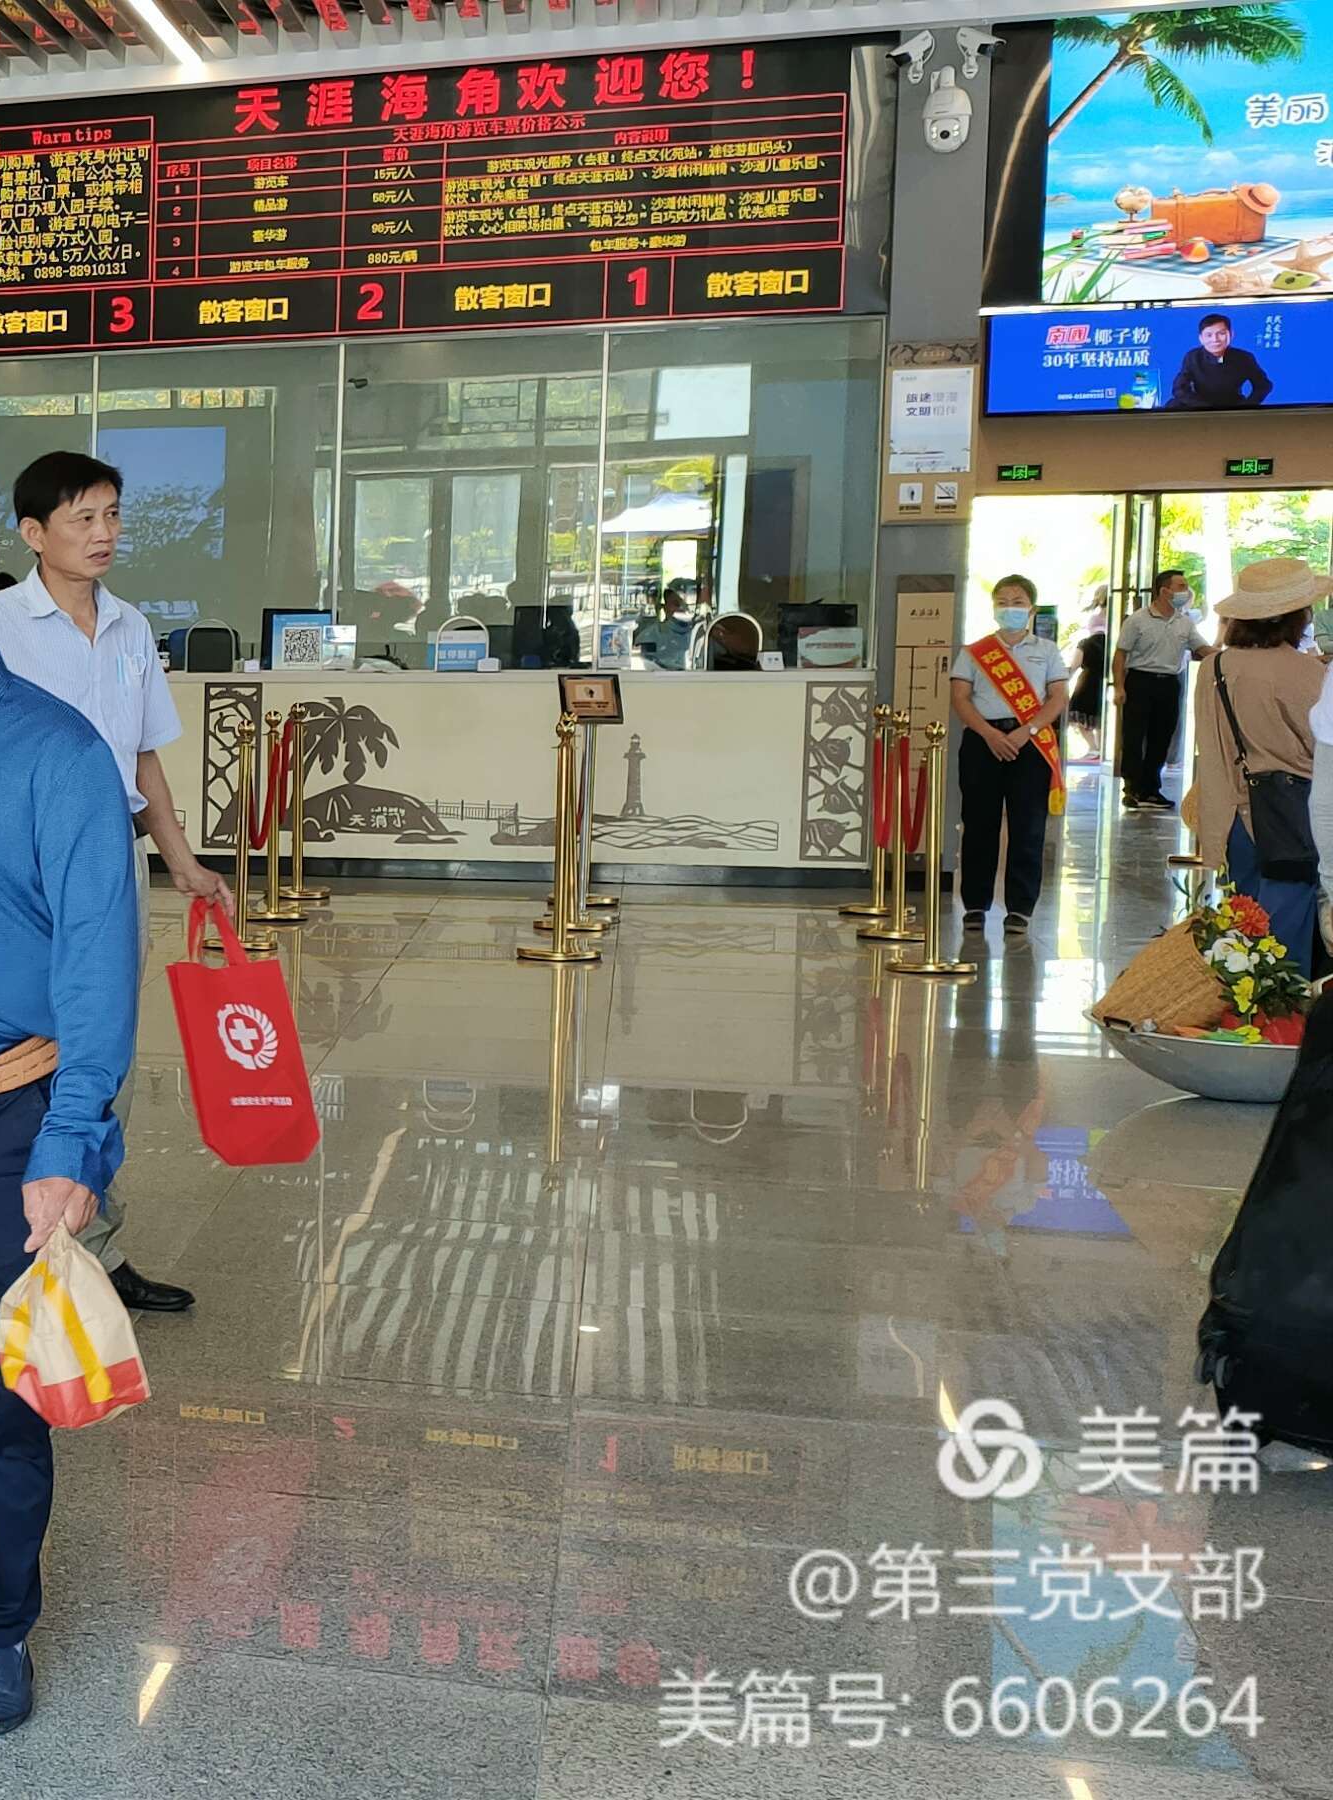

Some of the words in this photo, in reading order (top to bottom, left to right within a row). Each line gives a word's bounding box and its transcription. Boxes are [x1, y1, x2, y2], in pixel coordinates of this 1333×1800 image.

[1245, 93, 1328, 128] 美丽
[33, 130, 70, 146] Warm
[75, 127, 112, 143] tips
[166, 165, 191, 176] 序号
[173, 206, 181, 216] 2
[173, 236, 181, 246] 3
[173, 266, 180, 276] 4
[109, 297, 134, 333] 3
[198, 297, 289, 325] 散客窗口
[356, 283, 384, 320] 2
[454, 283, 552, 311] 散客窗口
[627, 267, 648, 307] 1
[706, 269, 809, 299] 散客窗口
[1094, 327, 1151, 345] 椰子粉
[1043, 349, 1150, 368] 30年坚持品质
